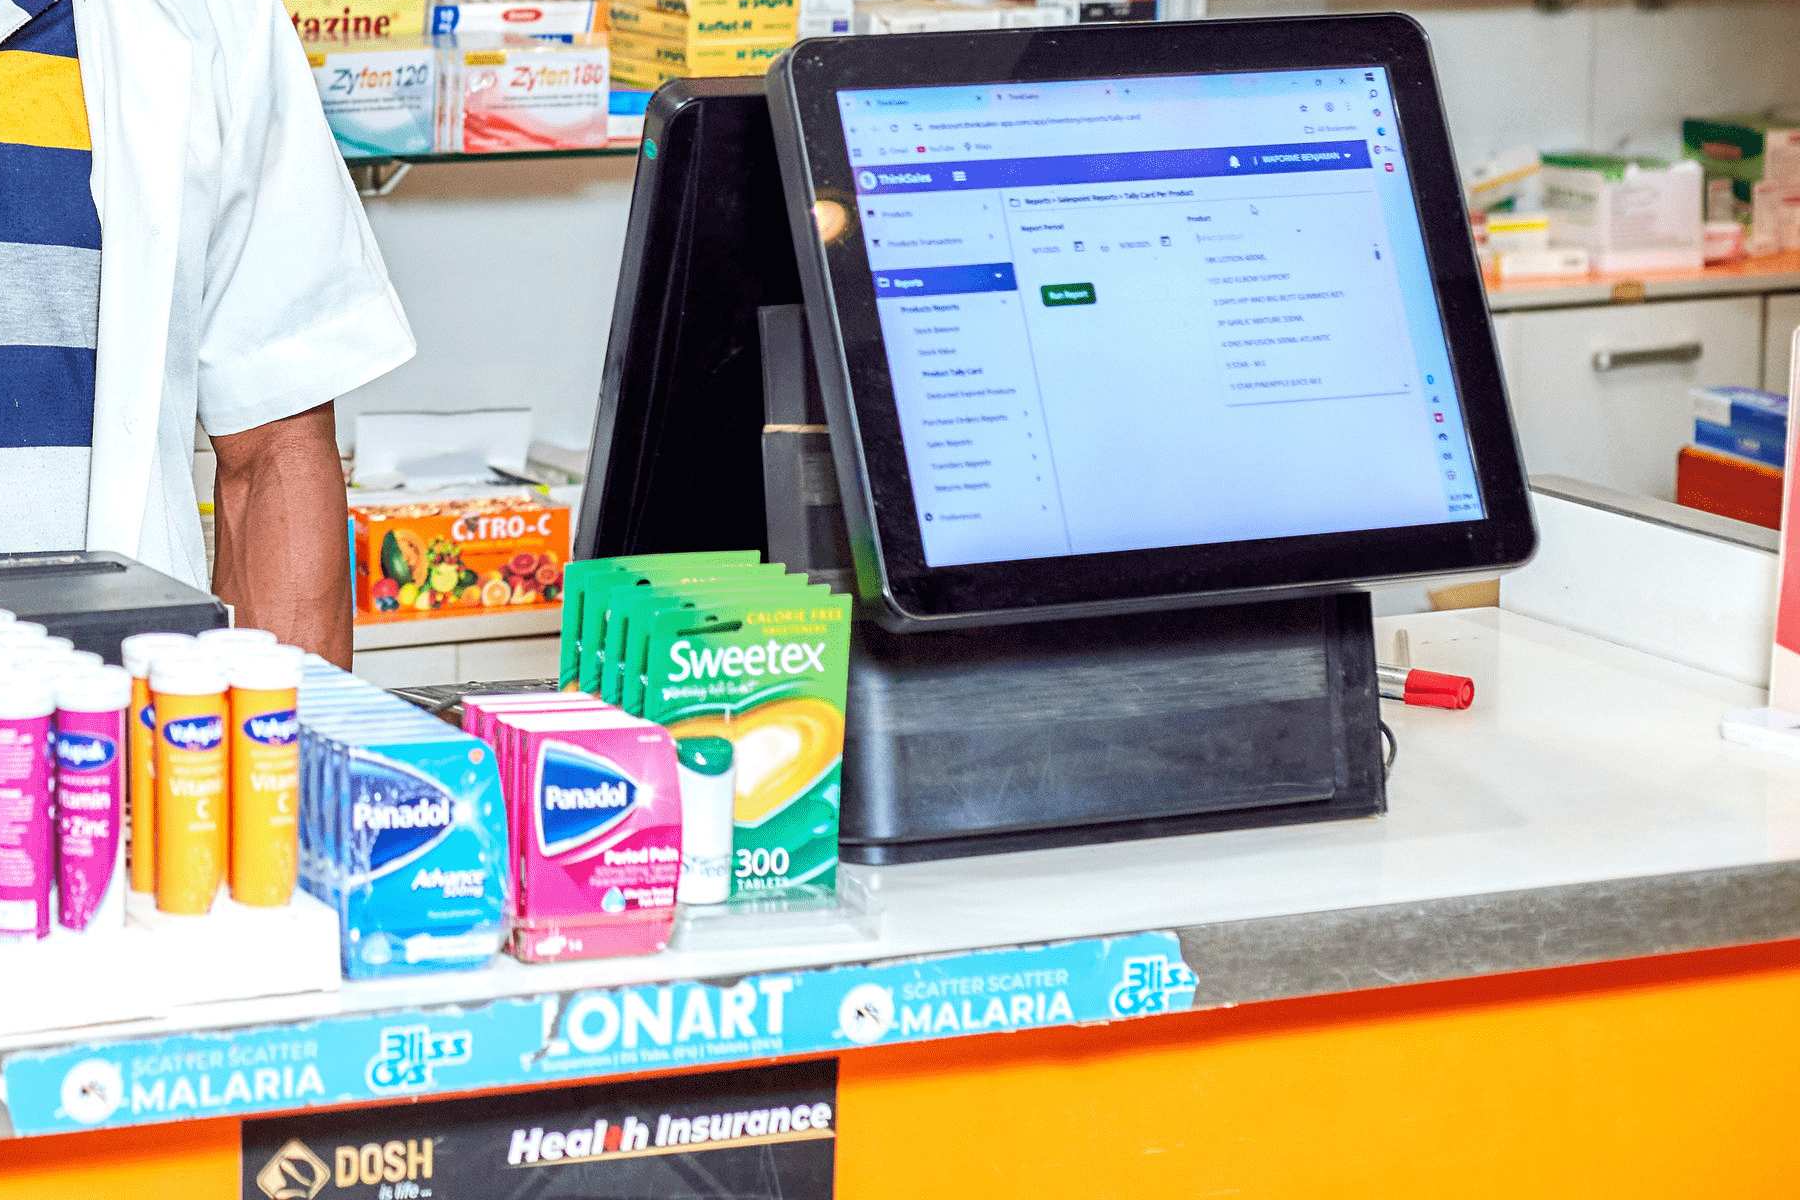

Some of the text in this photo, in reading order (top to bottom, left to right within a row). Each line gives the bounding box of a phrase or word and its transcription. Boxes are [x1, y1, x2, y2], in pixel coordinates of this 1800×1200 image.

[329, 66, 428, 93] Zyfen 120
[509, 65, 603, 90] Zyfen 180
[452, 513, 552, 542] CTRO-C
[746, 608, 843, 625] CALORIE FREE
[667, 639, 827, 683] Sweetex
[545, 780, 628, 811] Panadol
[353, 798, 450, 831] Panadol
[411, 868, 487, 891] Advance
[735, 846, 790, 880] 300
[903, 969, 1069, 1001] SCATTER SCATTER
[540, 980, 795, 1058] LONART
[901, 990, 1074, 1036] MALARIA
[131, 1041, 320, 1078] SCATTER SCATTER
[131, 1065, 326, 1116] MALARIA
[655, 1098, 833, 1147] Insurance
[334, 1137, 435, 1189] DOSH
